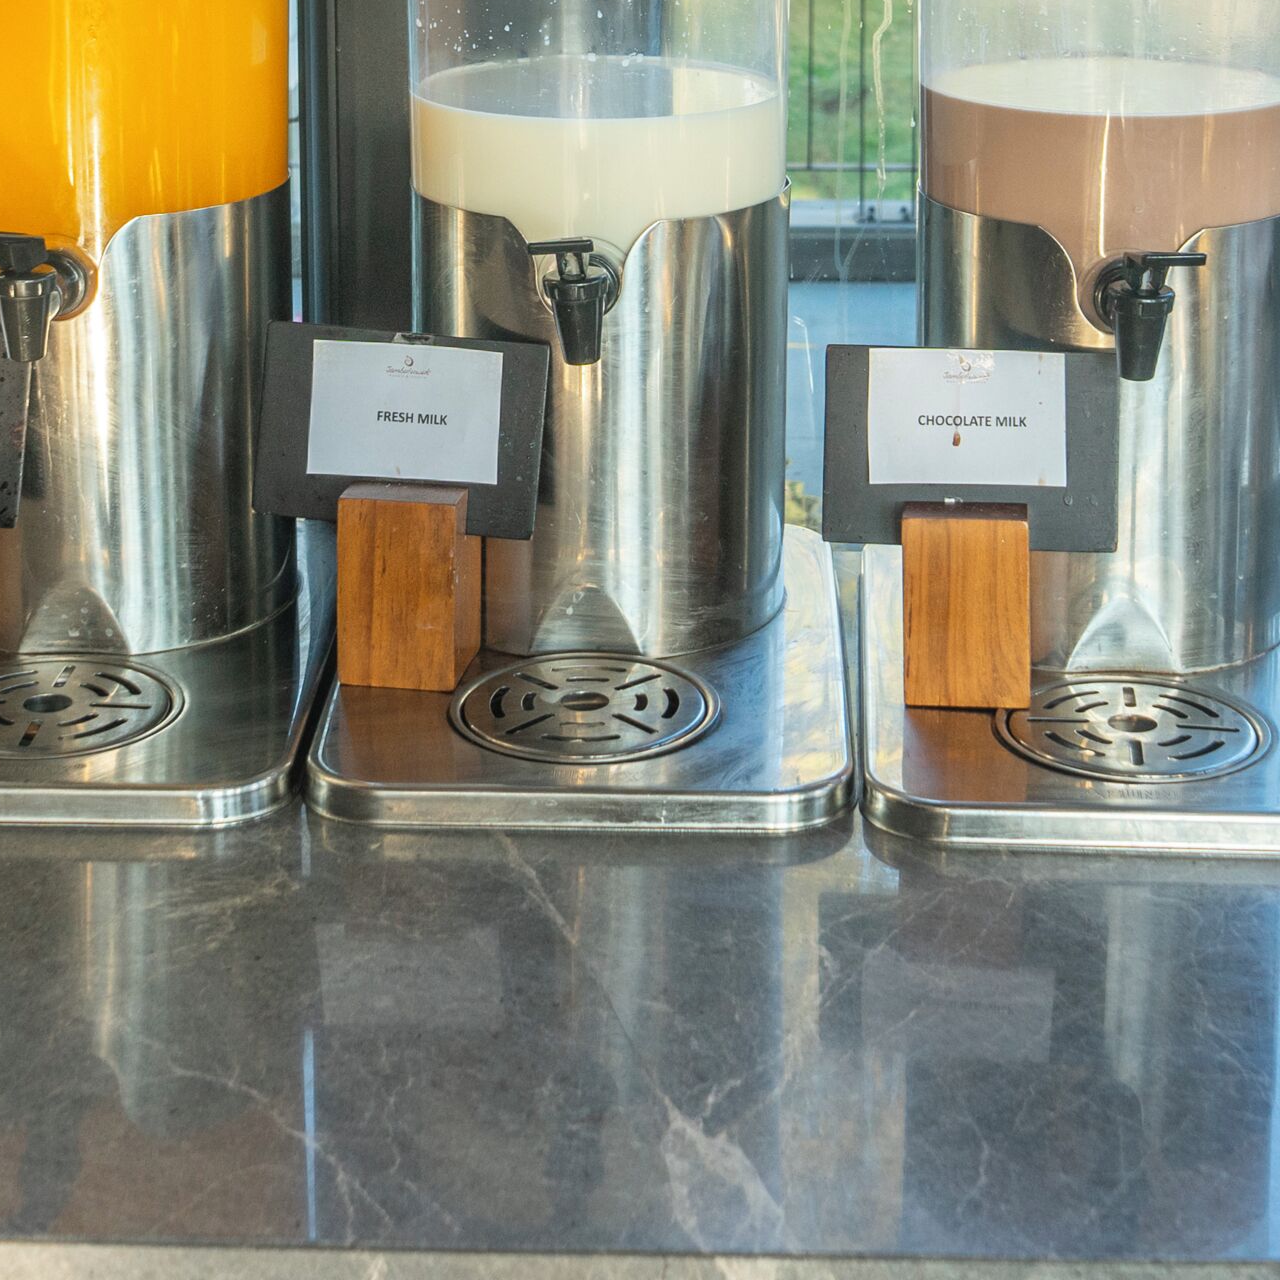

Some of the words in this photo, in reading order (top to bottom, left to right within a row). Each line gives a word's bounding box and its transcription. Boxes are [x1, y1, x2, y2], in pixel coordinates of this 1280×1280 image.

[376, 410, 414, 424] FRESH
[417, 412, 448, 426] MILK
[917, 414, 992, 428] CHOCOLATE
[995, 415, 1028, 428] MILK
